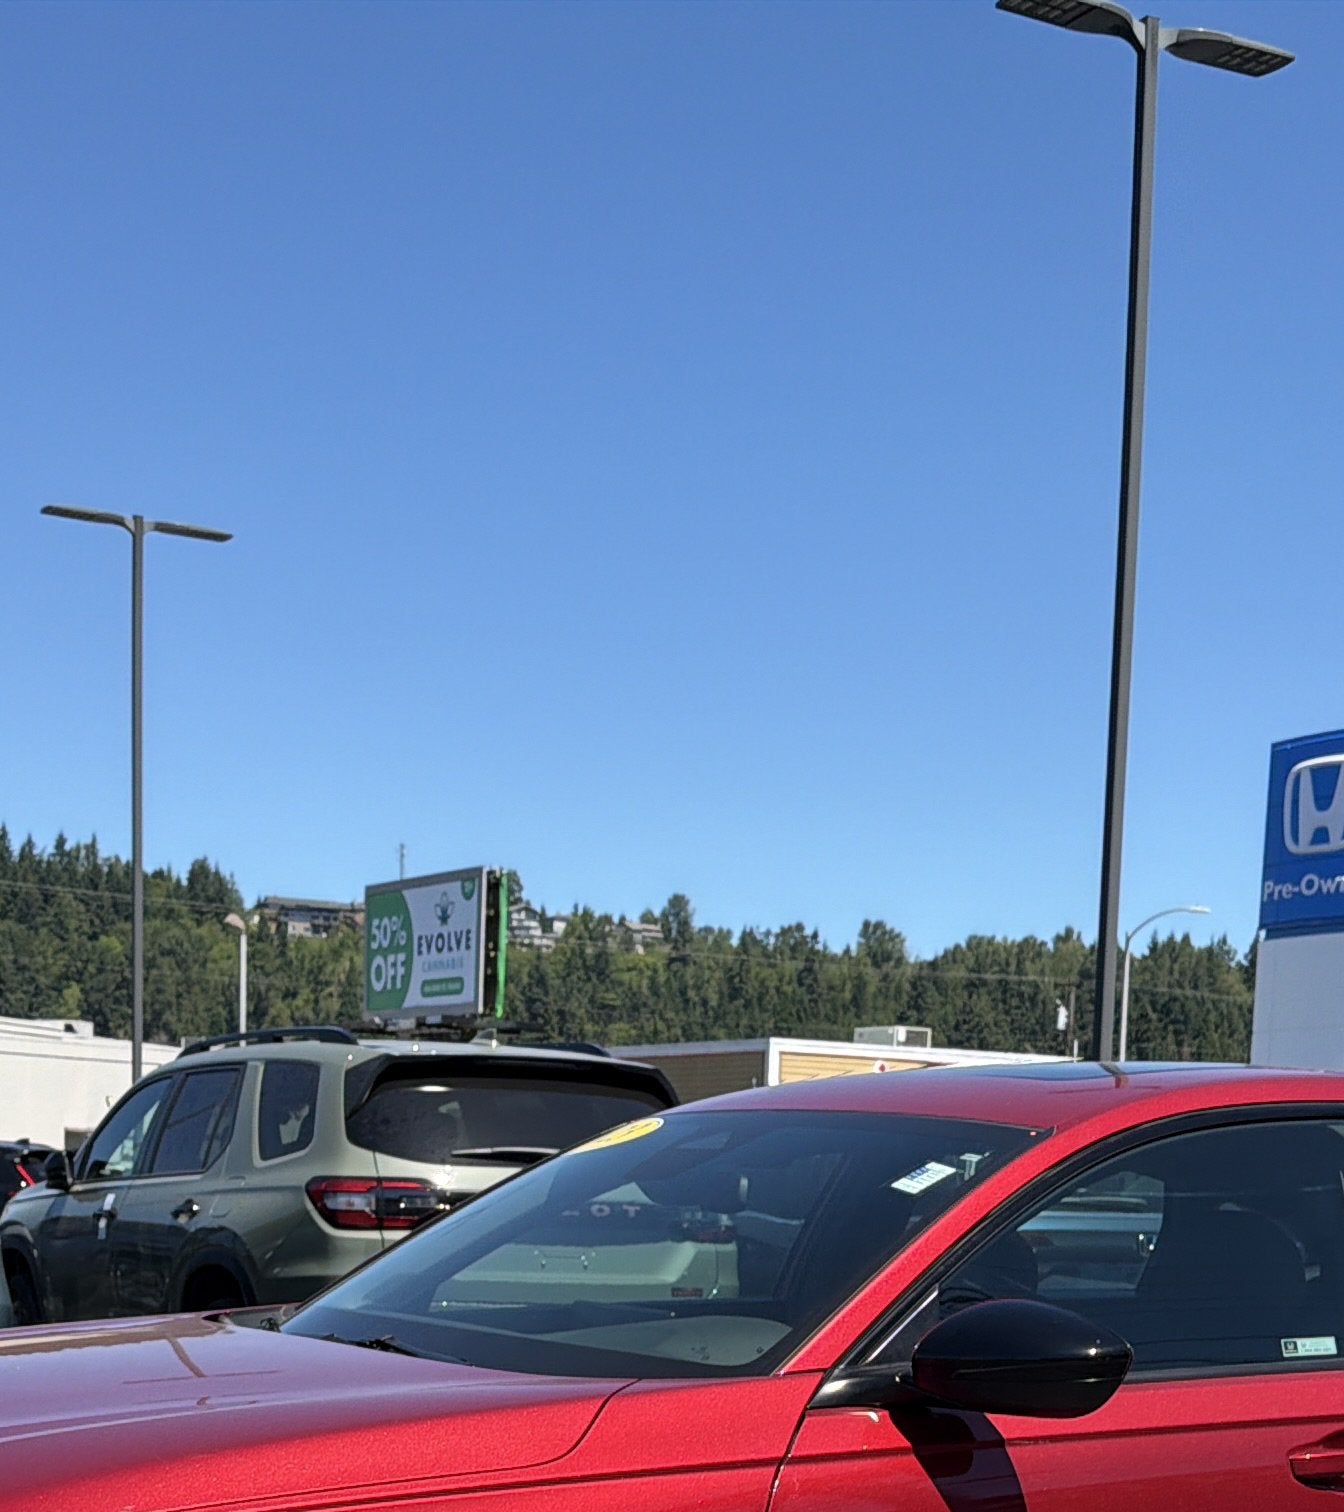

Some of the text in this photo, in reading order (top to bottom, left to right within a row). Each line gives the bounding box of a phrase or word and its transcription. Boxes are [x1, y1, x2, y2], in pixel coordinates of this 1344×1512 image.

[370, 914, 407, 950] 50%
[417, 928, 472, 957] EVOLVE
[370, 952, 407, 992] OFF
